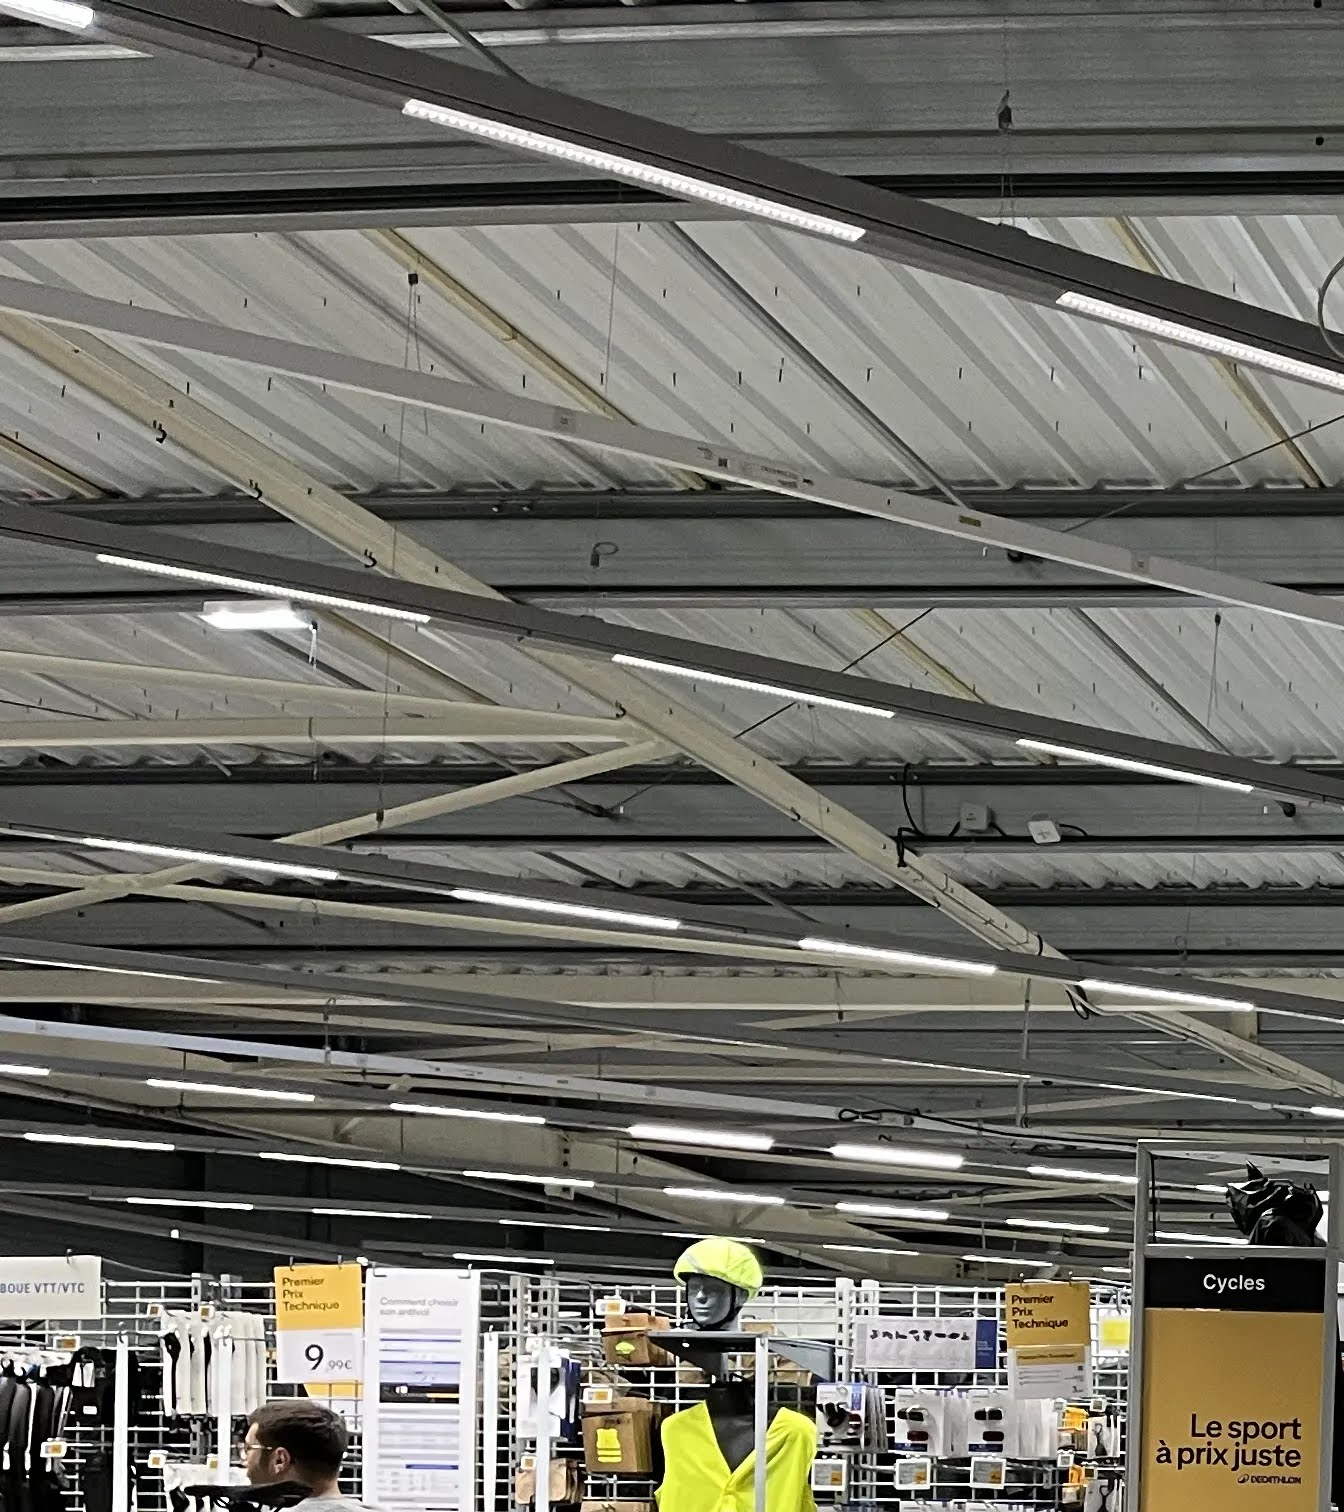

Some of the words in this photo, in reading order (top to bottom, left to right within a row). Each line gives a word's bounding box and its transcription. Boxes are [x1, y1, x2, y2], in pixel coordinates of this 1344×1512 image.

[282, 1277, 325, 1287] Premier
[1203, 1273, 1266, 1294] Cycles
[34, 1282, 85, 1295] VTT/VTC
[282, 1289, 304, 1299] Prix
[1011, 1294, 1054, 1305] Premier
[284, 1301, 340, 1312] Technique
[1012, 1307, 1033, 1317] Prix
[1013, 1319, 1069, 1330] Technique
[1191, 1413, 1223, 1438] Le
[1227, 1417, 1302, 1444] sport
[1156, 1439, 1172, 1464] à
[1177, 1440, 1229, 1470] prix
[1231, 1441, 1302, 1472] juste
